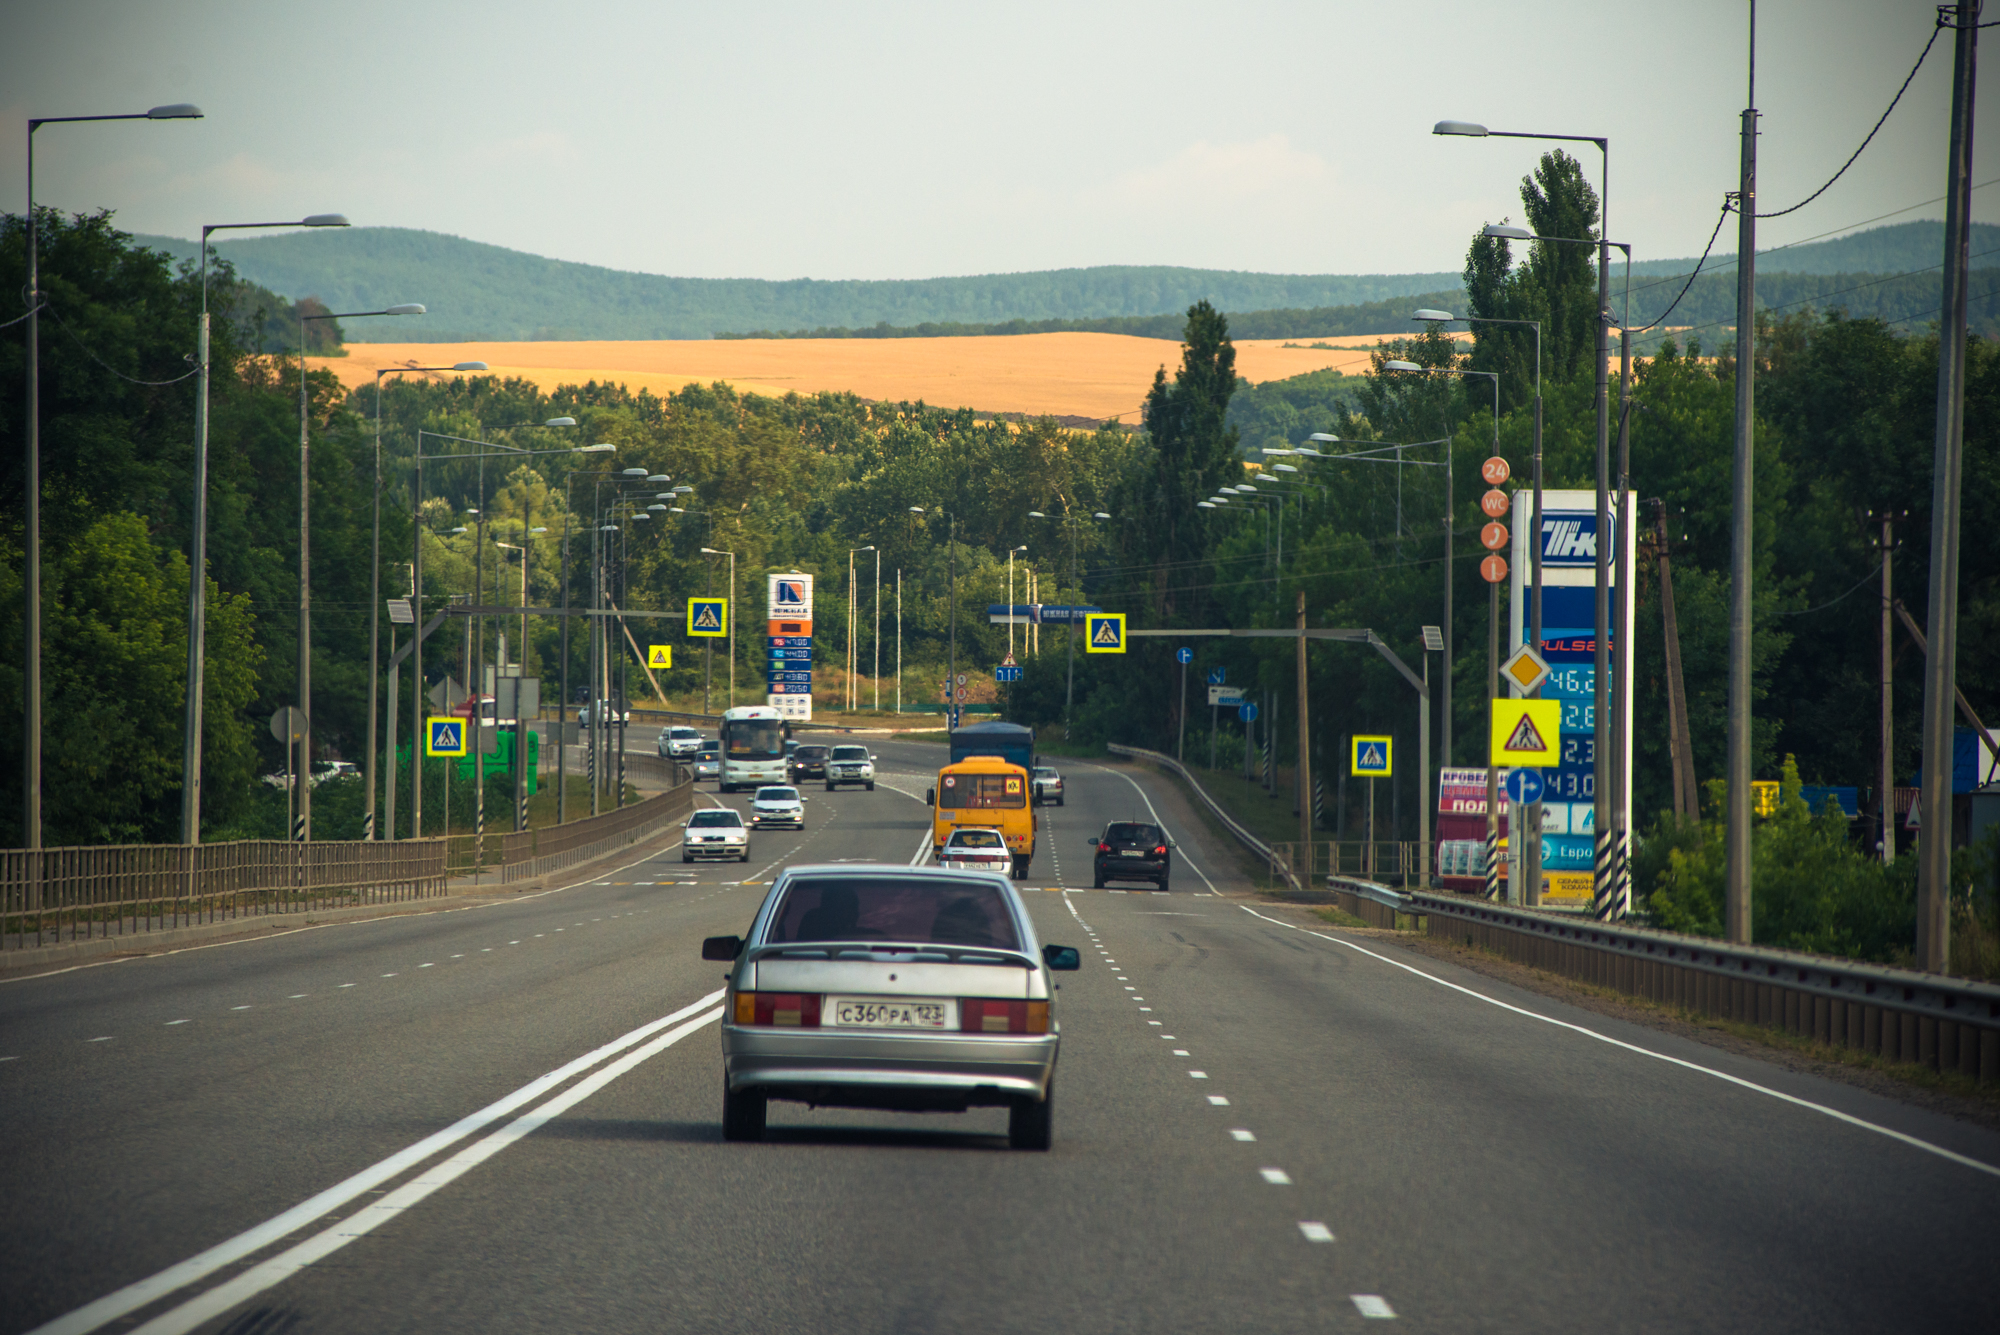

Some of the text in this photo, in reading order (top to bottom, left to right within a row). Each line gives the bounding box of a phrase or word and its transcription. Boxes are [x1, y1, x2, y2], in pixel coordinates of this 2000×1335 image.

[1485, 463, 1506, 479] 24
[1485, 498, 1505, 510] WC
[1550, 670, 1612, 694] 46.2
[1560, 844, 1593, 860] Евро
